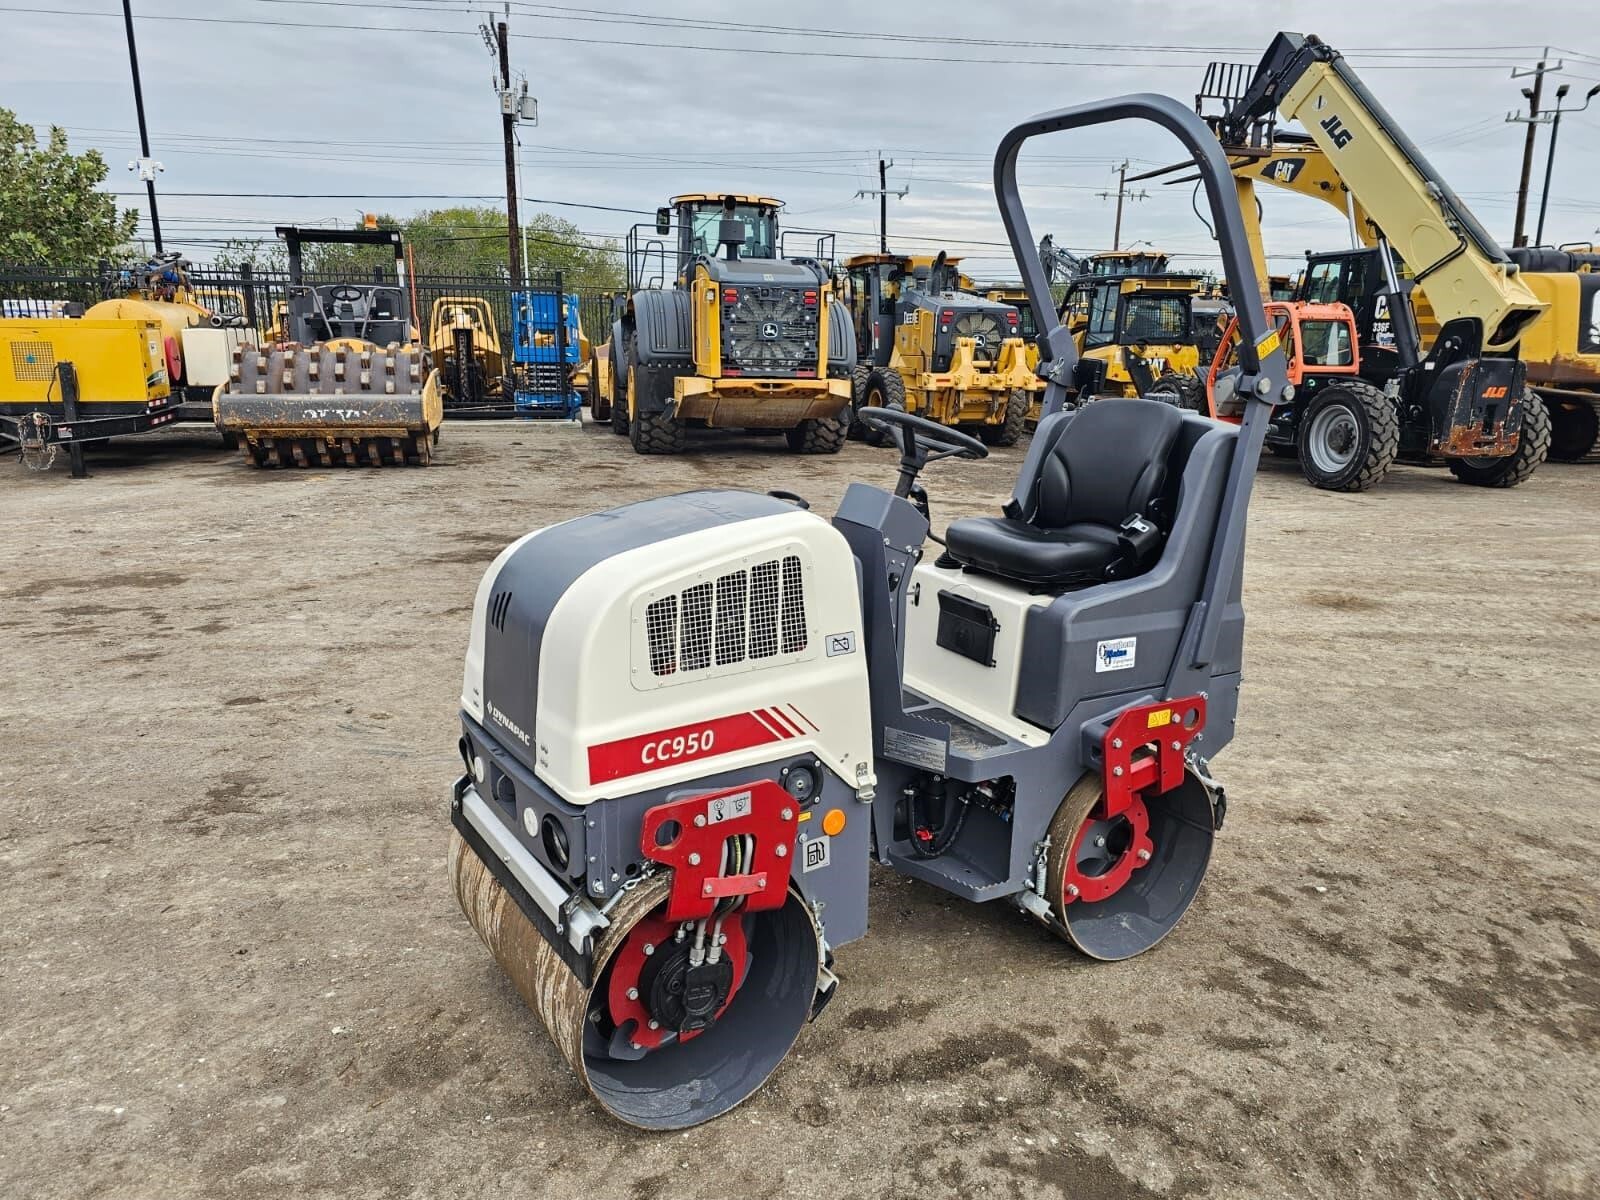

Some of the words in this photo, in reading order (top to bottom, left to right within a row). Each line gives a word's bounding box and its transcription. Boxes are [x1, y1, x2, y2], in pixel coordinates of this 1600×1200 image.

[1320, 115, 1353, 150] JLG
[1274, 161, 1294, 182] CAT
[1374, 295, 1391, 320] CA
[1481, 386, 1507, 398] JLG
[492, 707, 530, 747] DYNAPAC
[641, 729, 714, 764] CC950
